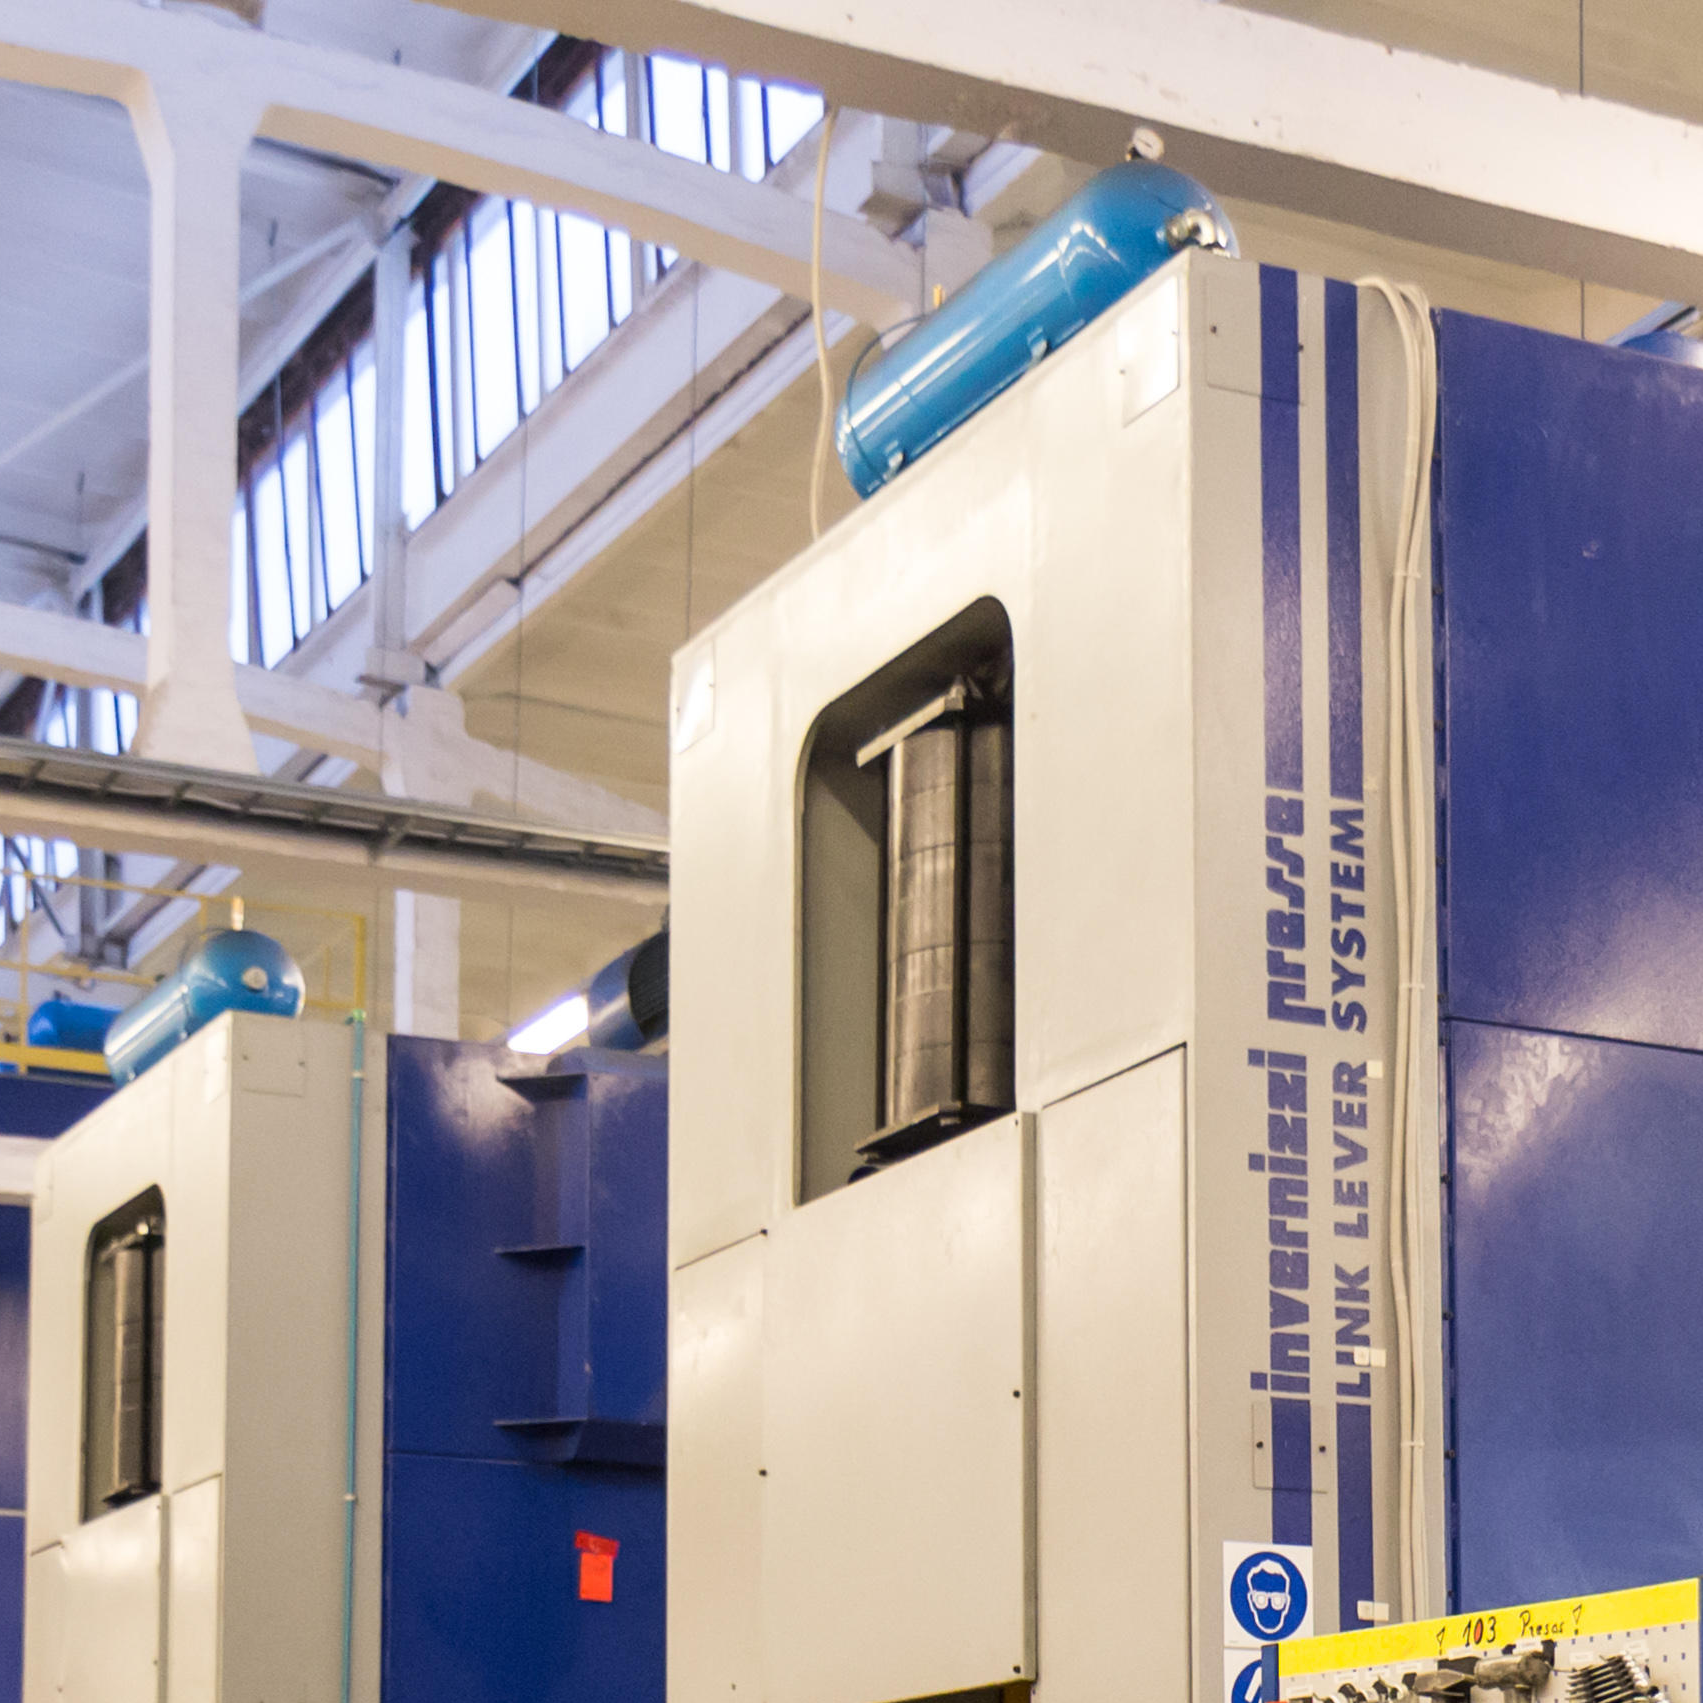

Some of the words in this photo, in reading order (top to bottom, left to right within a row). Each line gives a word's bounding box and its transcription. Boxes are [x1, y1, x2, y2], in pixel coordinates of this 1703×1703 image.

[1328, 801, 1368, 1034] SYSTEM
[1247, 1049, 1311, 1394] invernizzi
[1332, 1060, 1370, 1239] LEVER
[1335, 1264, 1372, 1398] LINK
[1462, 1615, 1497, 1648] 103
